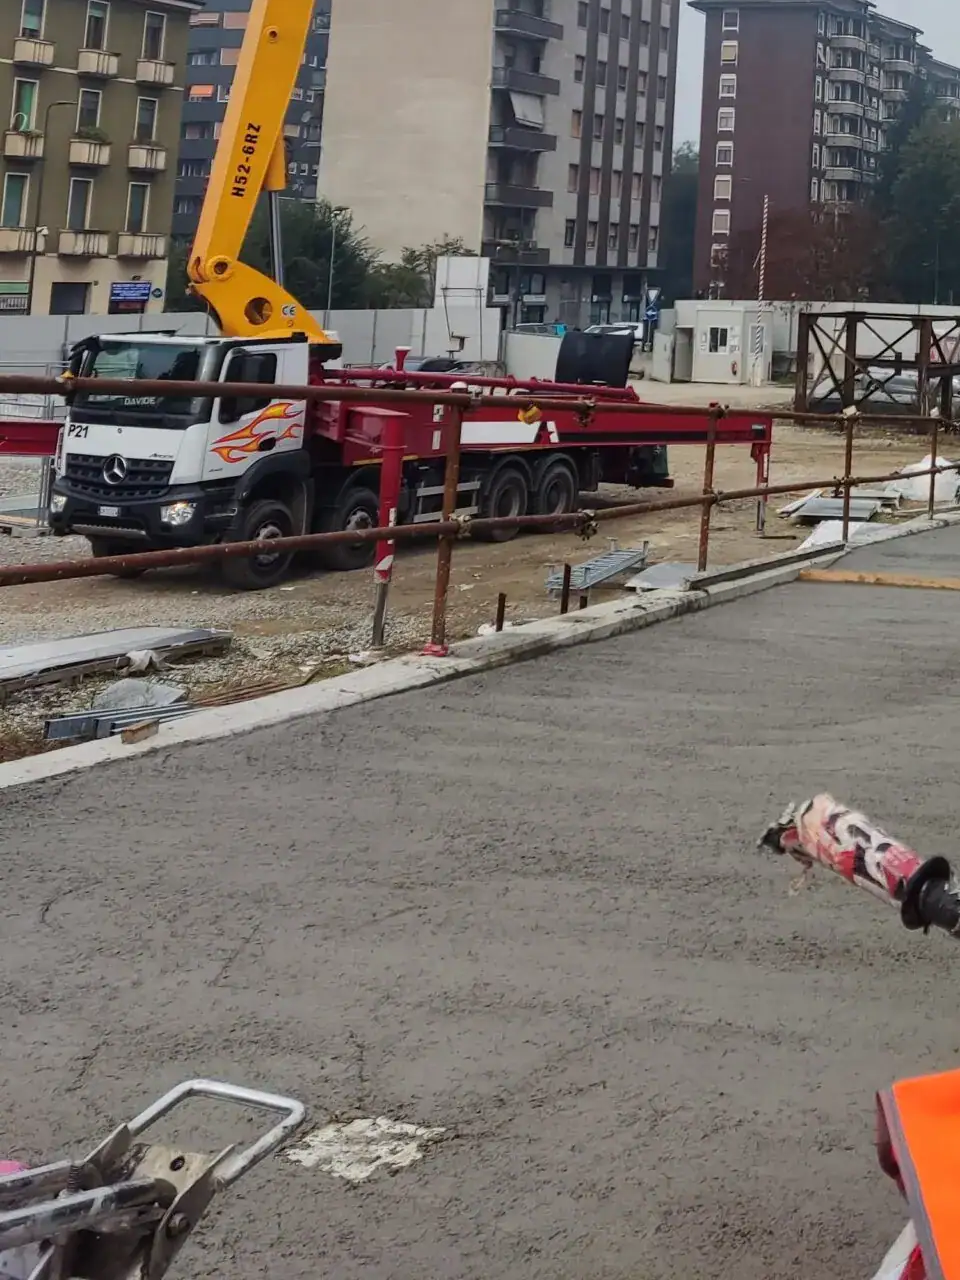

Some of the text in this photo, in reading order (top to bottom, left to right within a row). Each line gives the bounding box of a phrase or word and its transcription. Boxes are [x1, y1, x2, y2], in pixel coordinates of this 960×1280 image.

[231, 122, 262, 198] H52-6RZ
[124, 396, 156, 406] DAVIDE
[67, 424, 89, 438] P21
